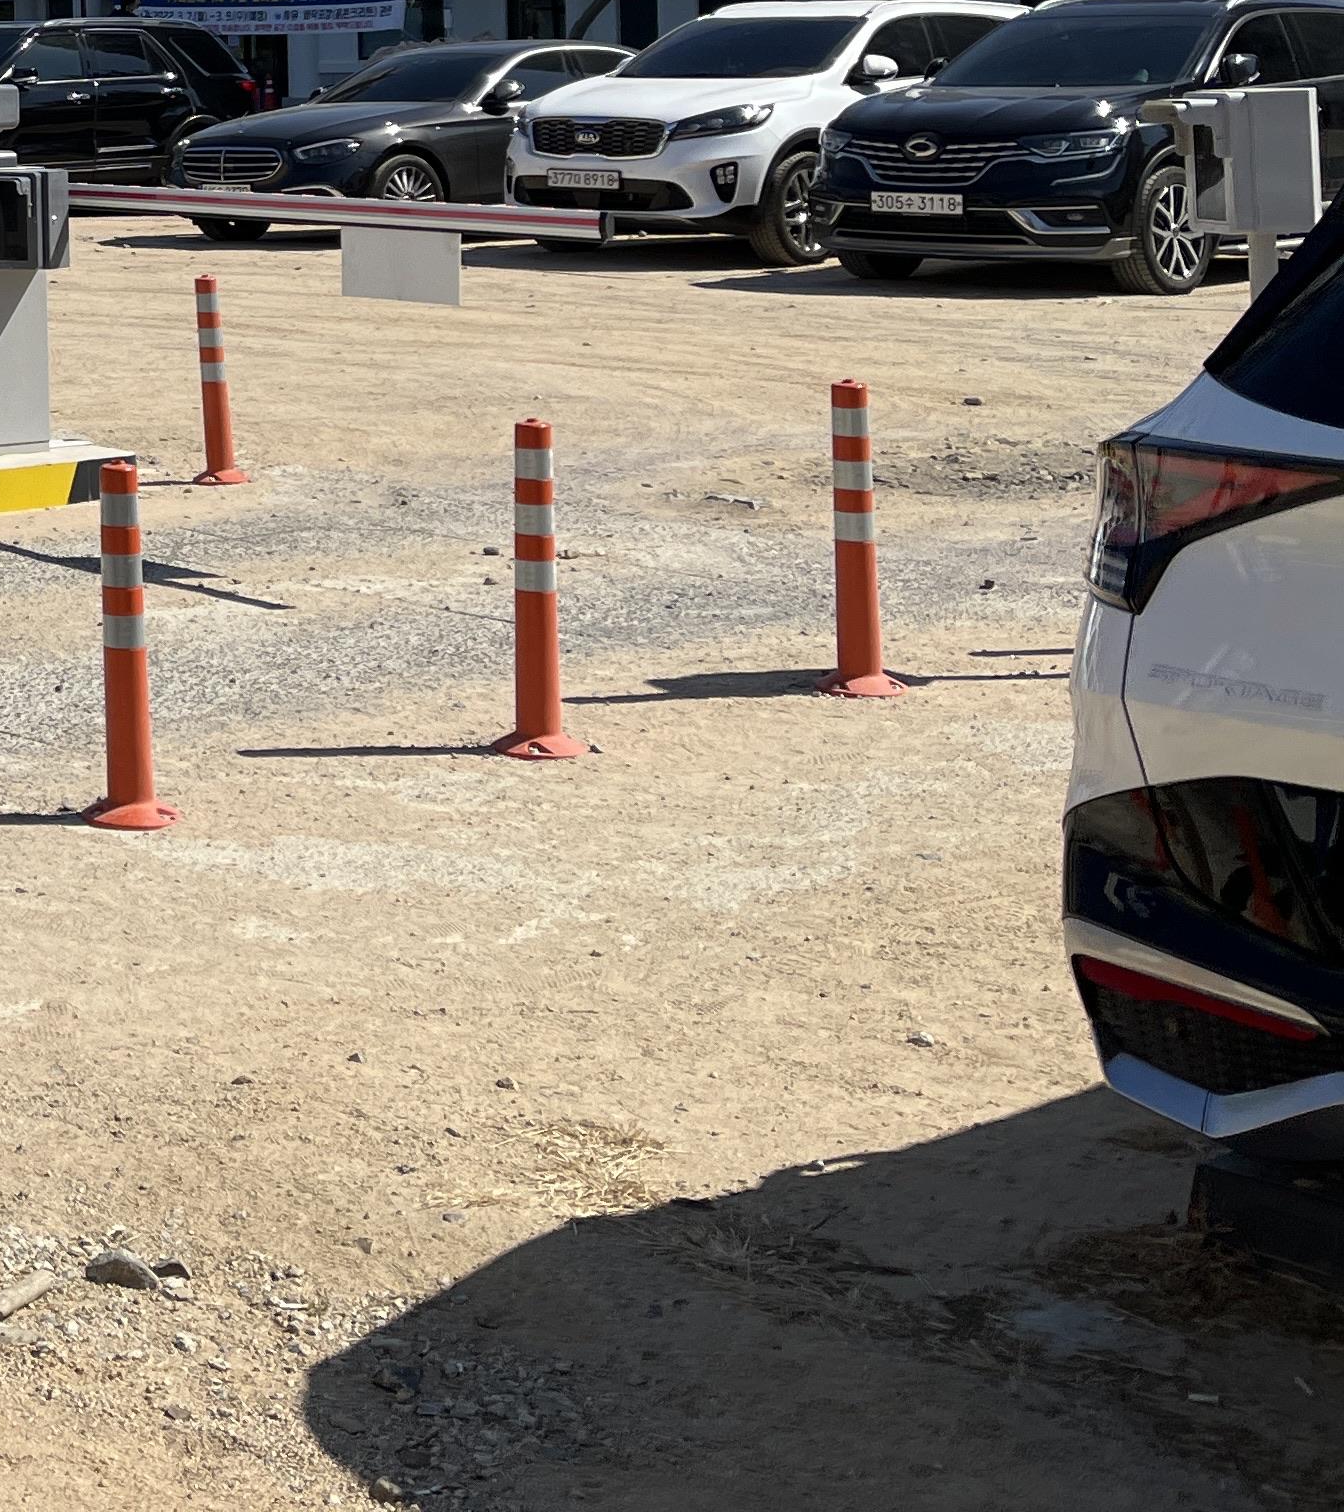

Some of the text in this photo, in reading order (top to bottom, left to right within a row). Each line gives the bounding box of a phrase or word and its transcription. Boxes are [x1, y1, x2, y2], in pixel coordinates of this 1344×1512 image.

[583, 171, 615, 187] 8918
[876, 194, 957, 212] 305수 3118
